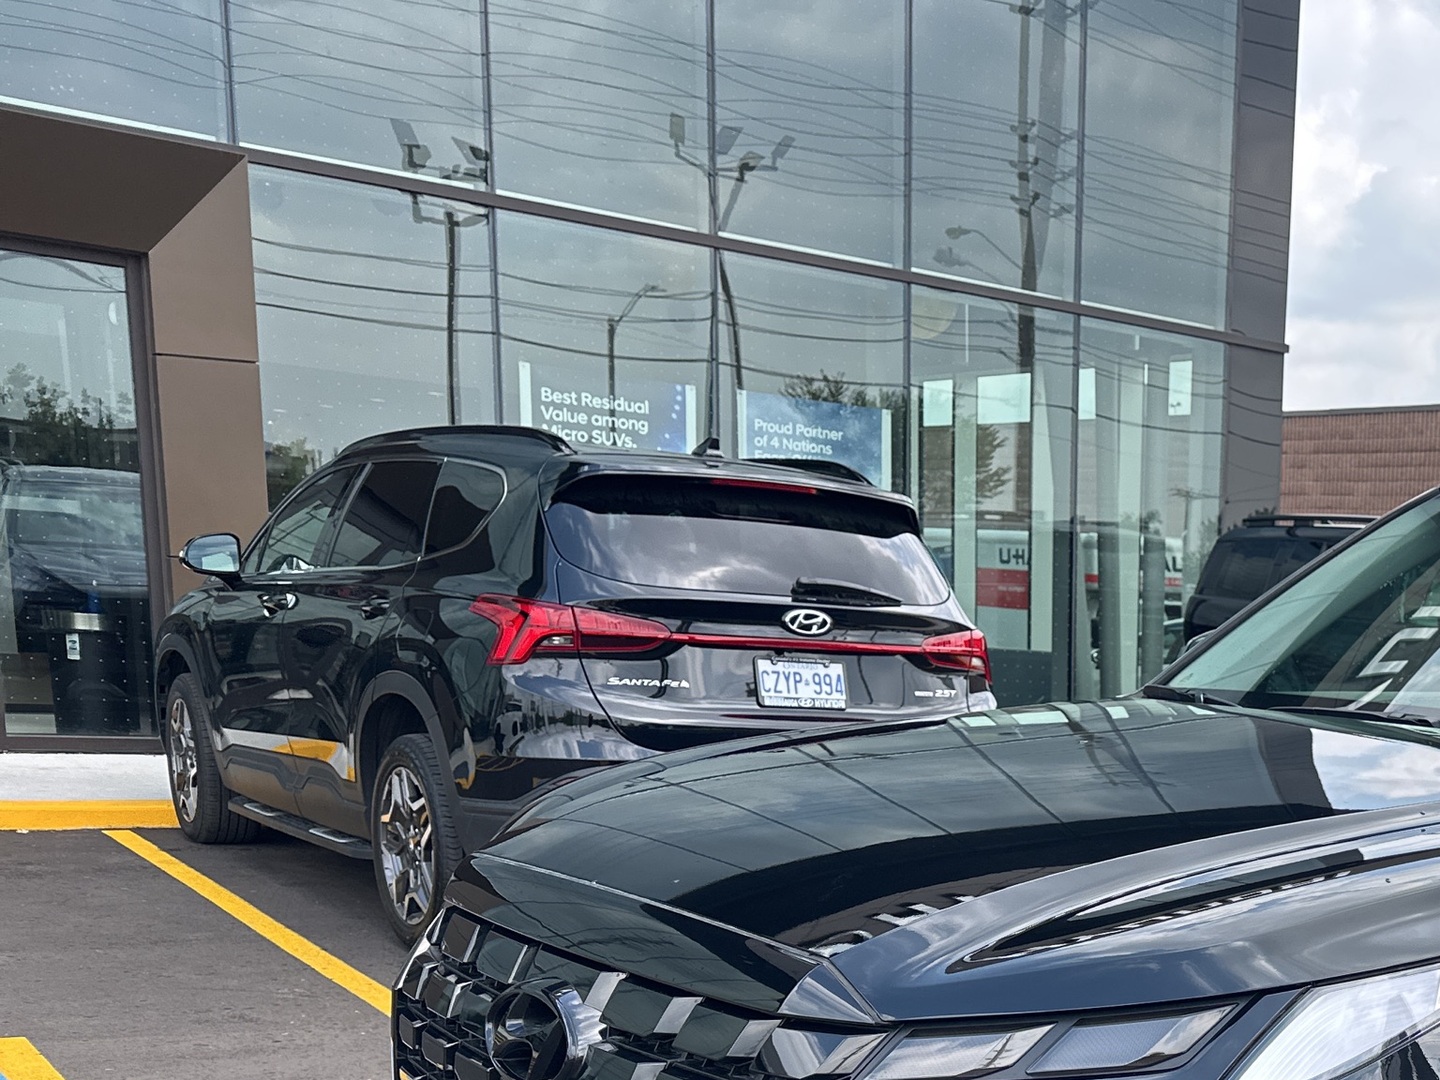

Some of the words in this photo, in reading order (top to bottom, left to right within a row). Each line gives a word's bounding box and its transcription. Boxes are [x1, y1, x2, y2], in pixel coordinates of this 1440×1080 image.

[541, 386, 578, 406] Best
[581, 391, 649, 415] Residual
[540, 404, 588, 425] Value
[591, 414, 649, 435] among
[754, 418, 793, 435] Proud
[796, 423, 844, 442] Partner
[592, 429, 637, 449] SUVs.
[754, 434, 768, 448] of
[770, 436, 780, 449] 4
[782, 438, 833, 456] Nations
